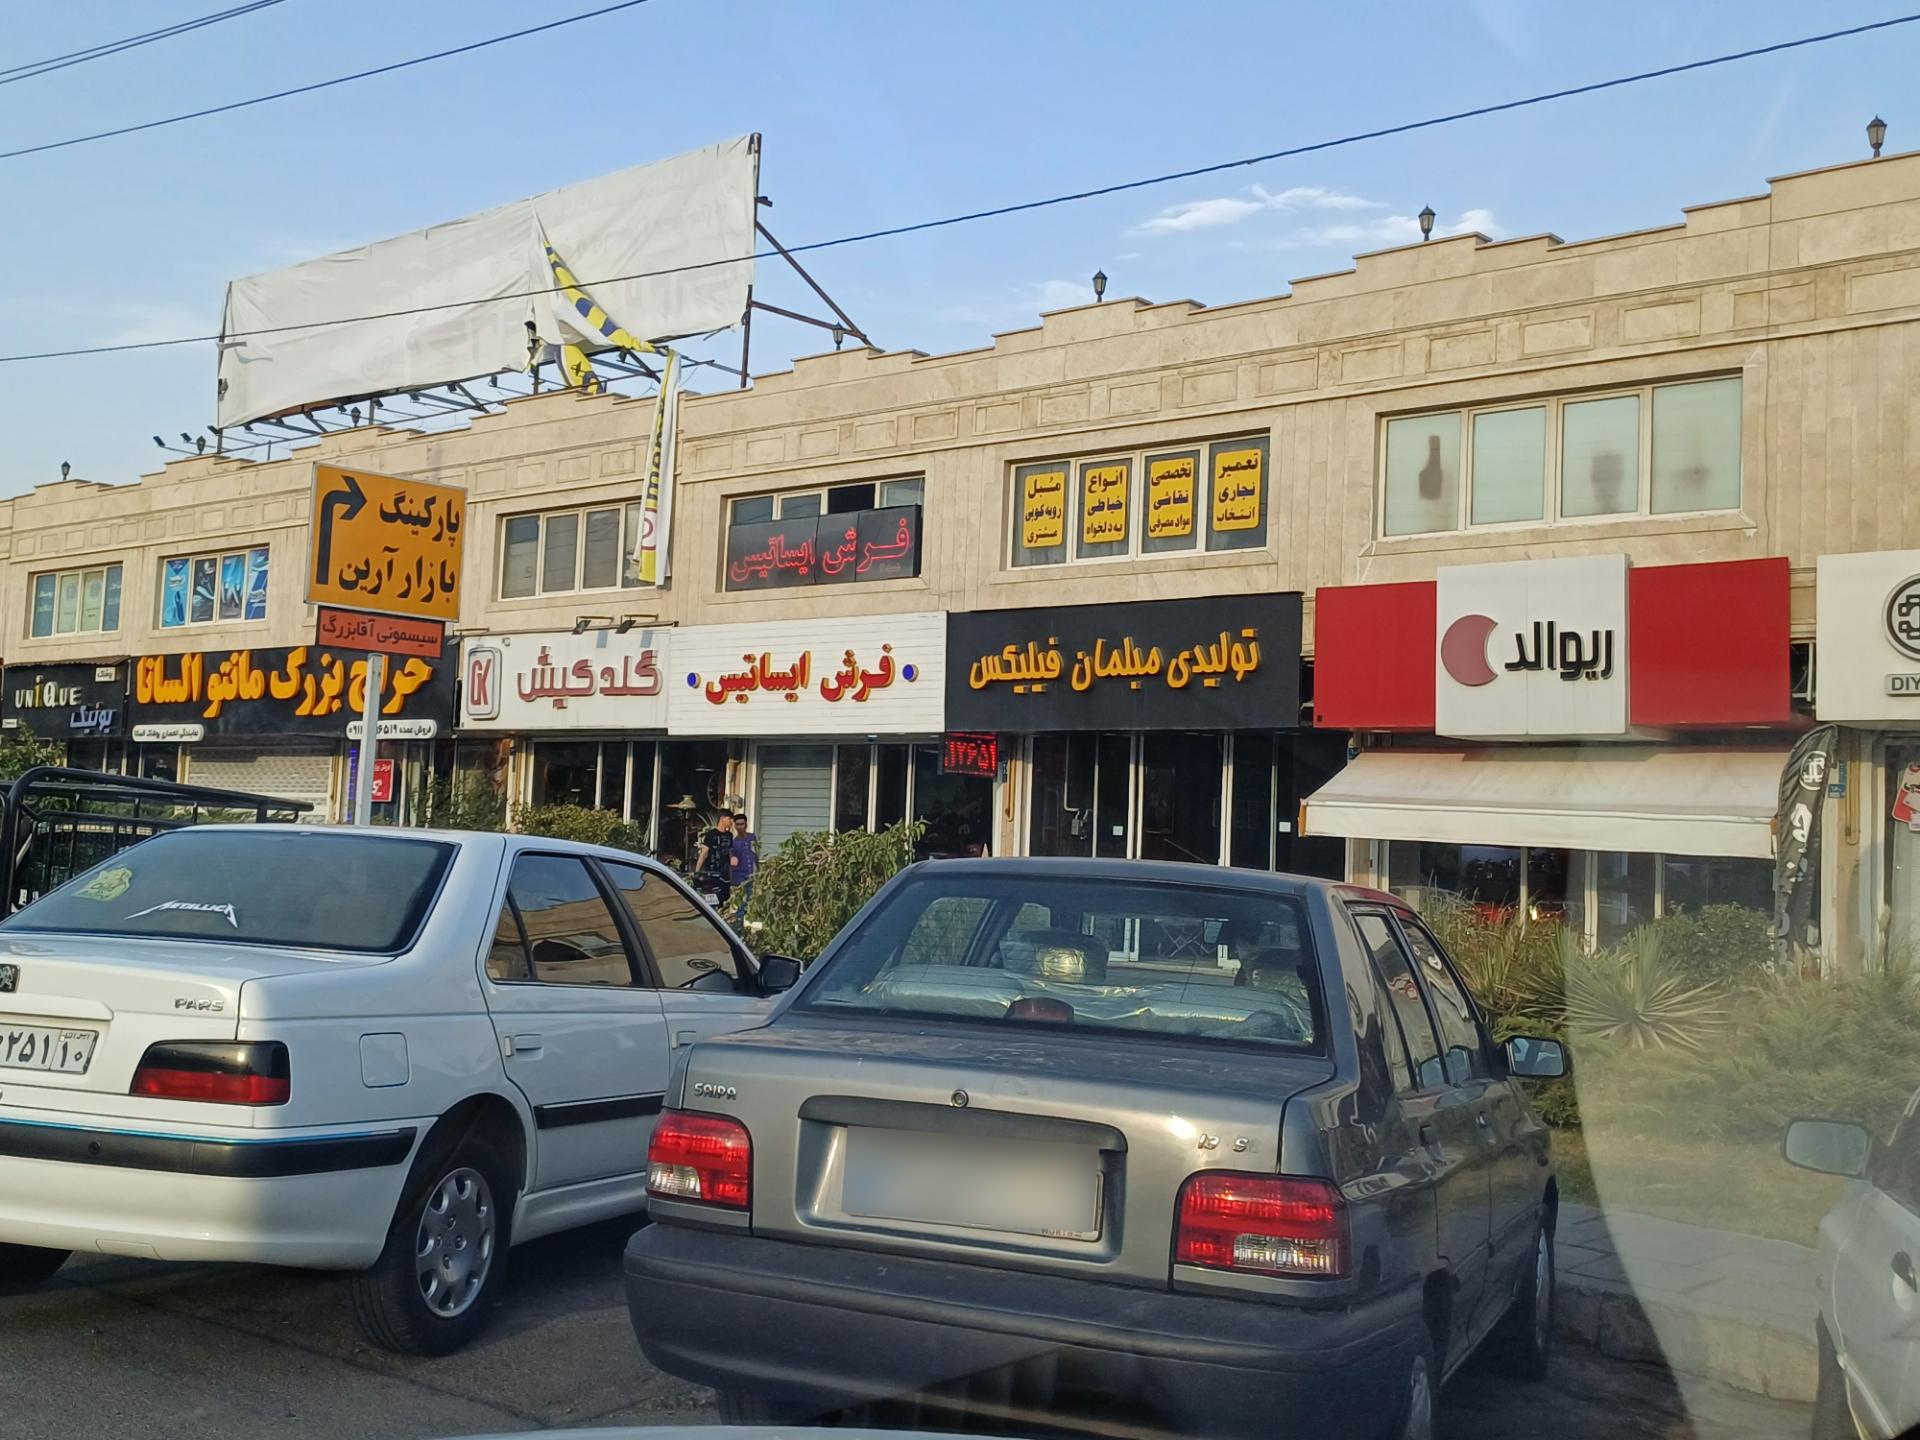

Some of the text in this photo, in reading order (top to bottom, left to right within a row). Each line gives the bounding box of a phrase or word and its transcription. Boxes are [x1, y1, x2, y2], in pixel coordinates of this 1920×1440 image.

[1151, 462, 1191, 486] تخصصی
[1218, 452, 1258, 478] تعمیر
[1088, 469, 1123, 493] انواع
[1218, 481, 1256, 503] نجاری
[1087, 496, 1123, 516] خیاطی
[1153, 489, 1189, 510] نقاشی
[379, 490, 460, 547] پارکینگ
[1149, 514, 1190, 533] مواد مصرفی
[1216, 506, 1256, 525] انتخاب
[1027, 526, 1058, 543] مشتری
[731, 517, 911, 582] فرش ایساتیس
[338, 545, 456, 604] بازار آرین
[322, 615, 439, 647] سیسمونی آقابزرگ
[968, 627, 1261, 694] تولیدی مبلمان فیلیکس
[1503, 620, 1616, 682] ریوالد
[202, 649, 266, 719] مانتو
[269, 646, 346, 717] بزرگ
[705, 643, 895, 705] فرش ایساتیس
[69, 701, 117, 734] یونیک
[399, 726, 413, 734] عمده
[414, 724, 432, 736] فروش
[174, 997, 225, 1012] PARS
[64, 1031, 91, 1040] ایران
[693, 1082, 737, 1101] SAIPA
